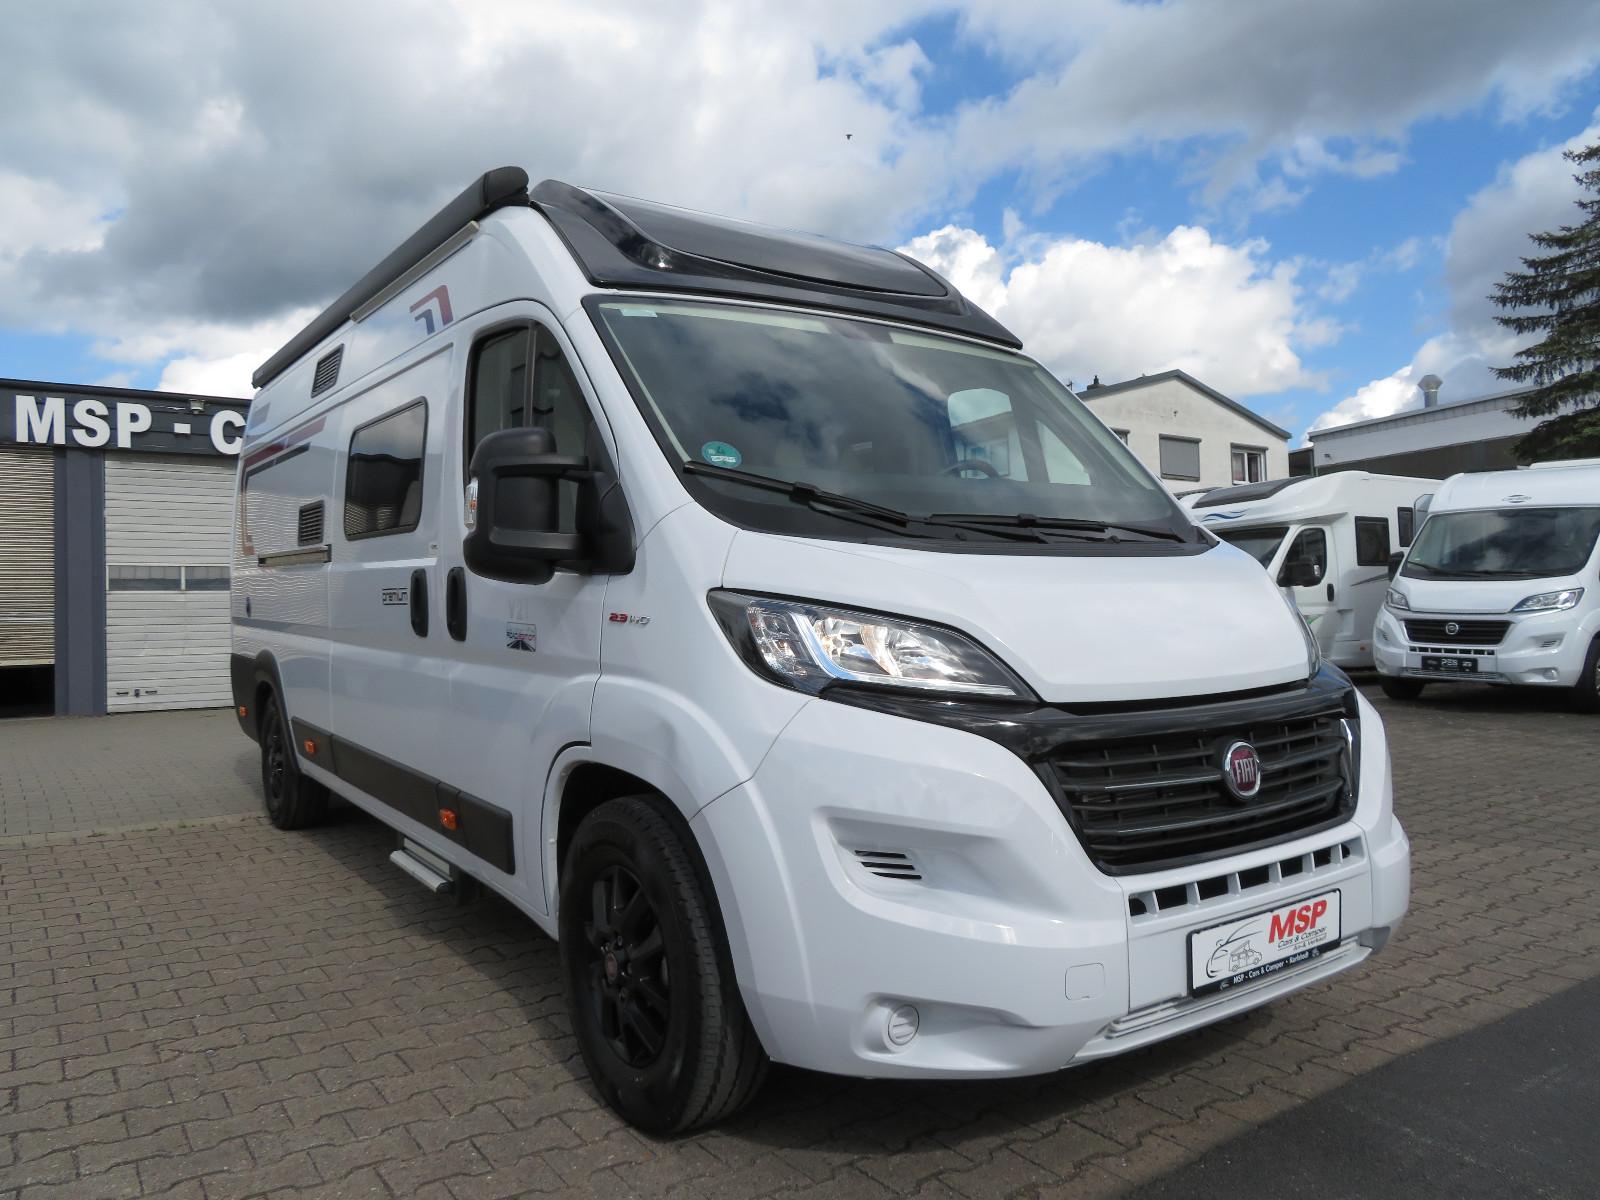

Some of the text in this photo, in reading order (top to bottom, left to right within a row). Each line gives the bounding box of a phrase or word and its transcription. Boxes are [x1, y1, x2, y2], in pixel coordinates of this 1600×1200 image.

[16, 395, 152, 448] MSP
[174, 422, 191, 434] -
[1234, 757, 1255, 783] FIAT
[1269, 900, 1327, 943] MSP
[1278, 938, 1293, 948] Cars
[1301, 927, 1327, 941] Camper
[1233, 973, 1244, 984] MSP
[1248, 969, 1260, 978] Cars
[1265, 960, 1284, 972] Camper
